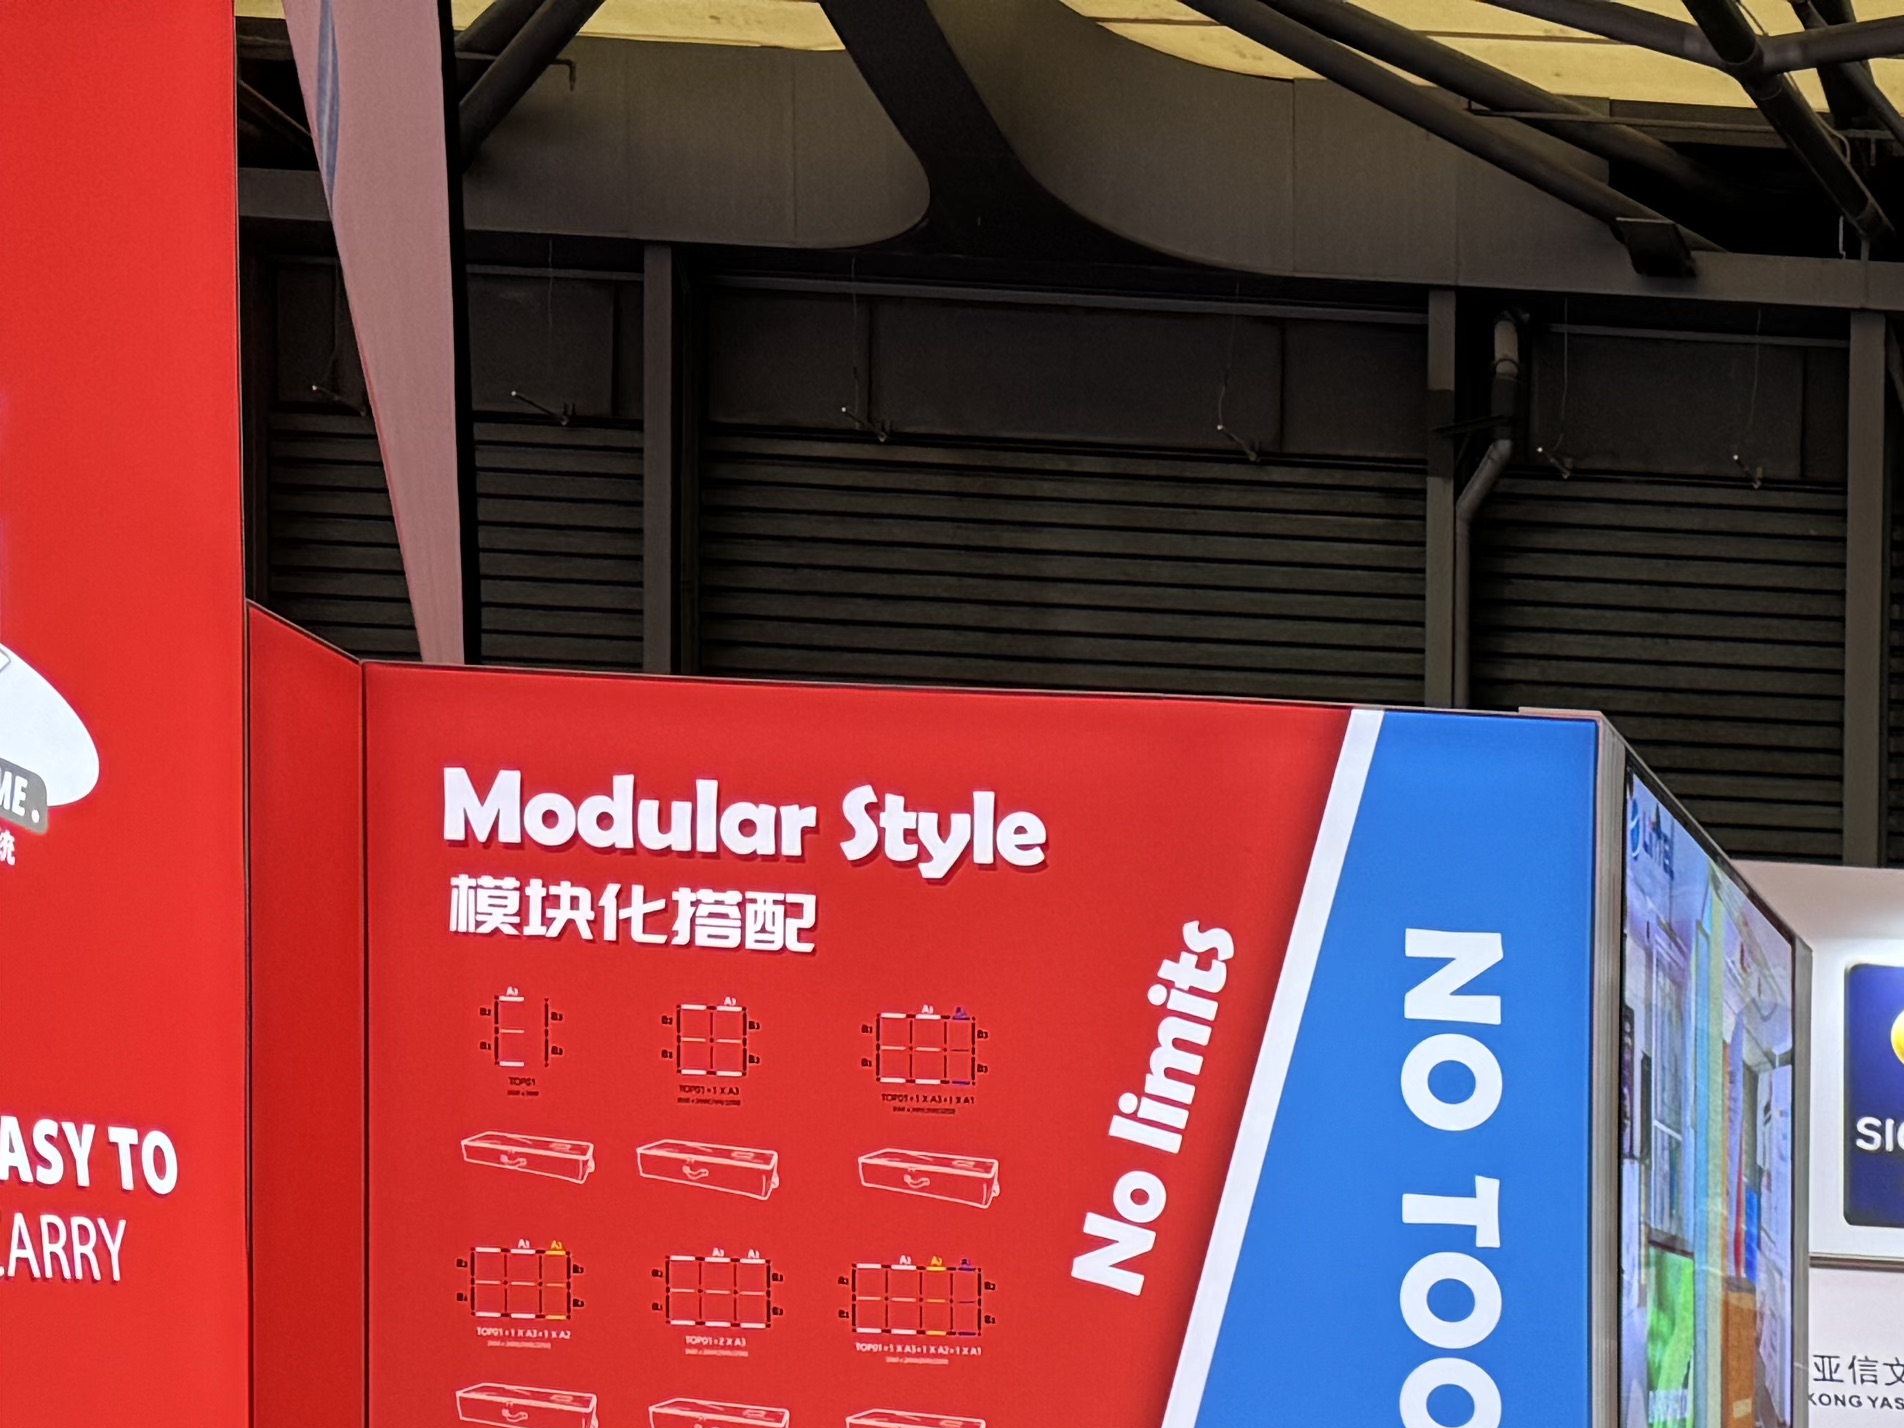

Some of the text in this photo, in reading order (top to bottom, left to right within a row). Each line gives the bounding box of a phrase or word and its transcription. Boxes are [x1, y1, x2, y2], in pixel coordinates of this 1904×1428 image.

[442, 767, 1047, 879] Modular Style
[449, 875, 817, 954] 模块化搭配
[1402, 927, 1504, 1132] NO
[1070, 919, 1235, 1297] No limits
[108, 1126, 179, 1196] TO
[0, 1212, 127, 1283] ARRY
